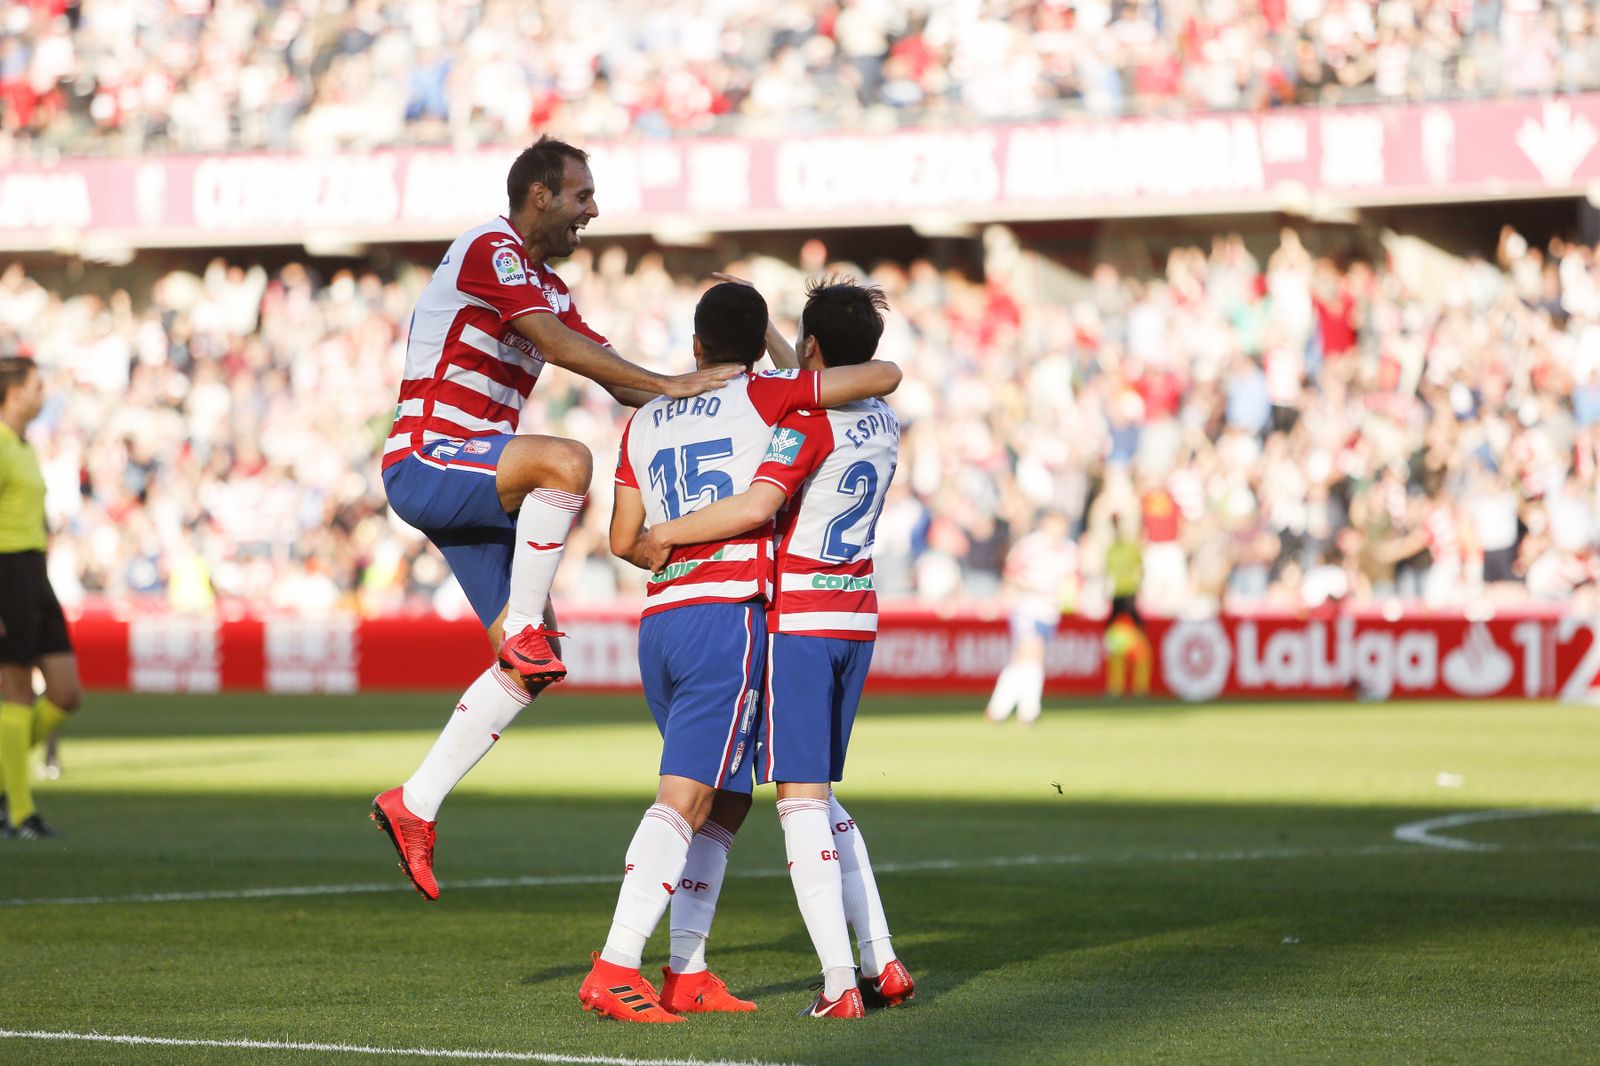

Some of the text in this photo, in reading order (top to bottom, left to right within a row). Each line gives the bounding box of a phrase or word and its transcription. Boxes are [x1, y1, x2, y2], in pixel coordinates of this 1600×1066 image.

[502, 273, 524, 284] LaLiga
[653, 395, 722, 429] PEDRO
[648, 437, 733, 521] 15
[1236, 614, 1438, 702] LaLiga
[677, 879, 708, 892] CF
